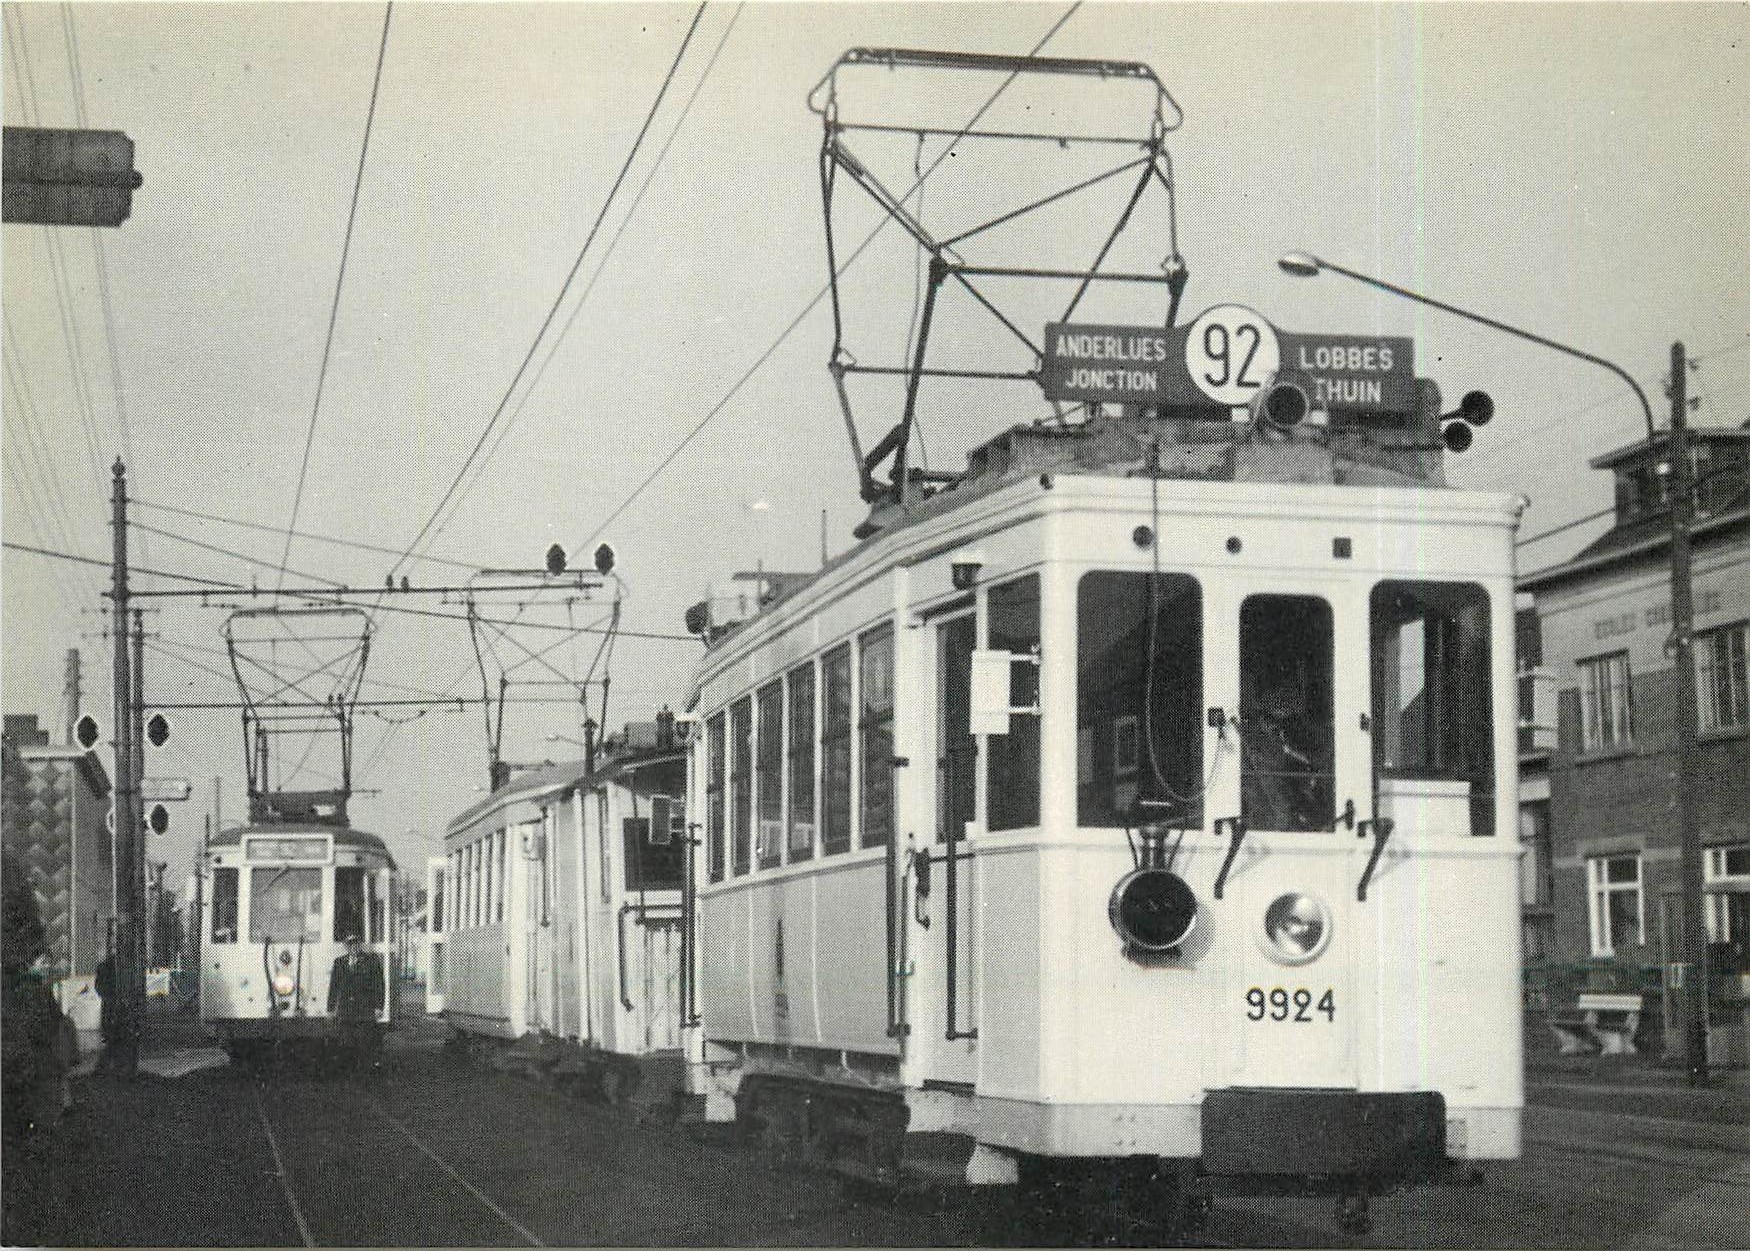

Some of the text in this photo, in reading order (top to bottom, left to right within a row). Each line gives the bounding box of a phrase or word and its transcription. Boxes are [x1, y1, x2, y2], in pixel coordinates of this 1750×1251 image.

[1056, 335, 1166, 362] ANDERLUES
[1204, 323, 1261, 389] 92
[1299, 345, 1394, 371] LOBBES
[1065, 368, 1157, 391] JONCTION
[1315, 379, 1382, 403] THUIN
[1246, 987, 1336, 1022] 9924
